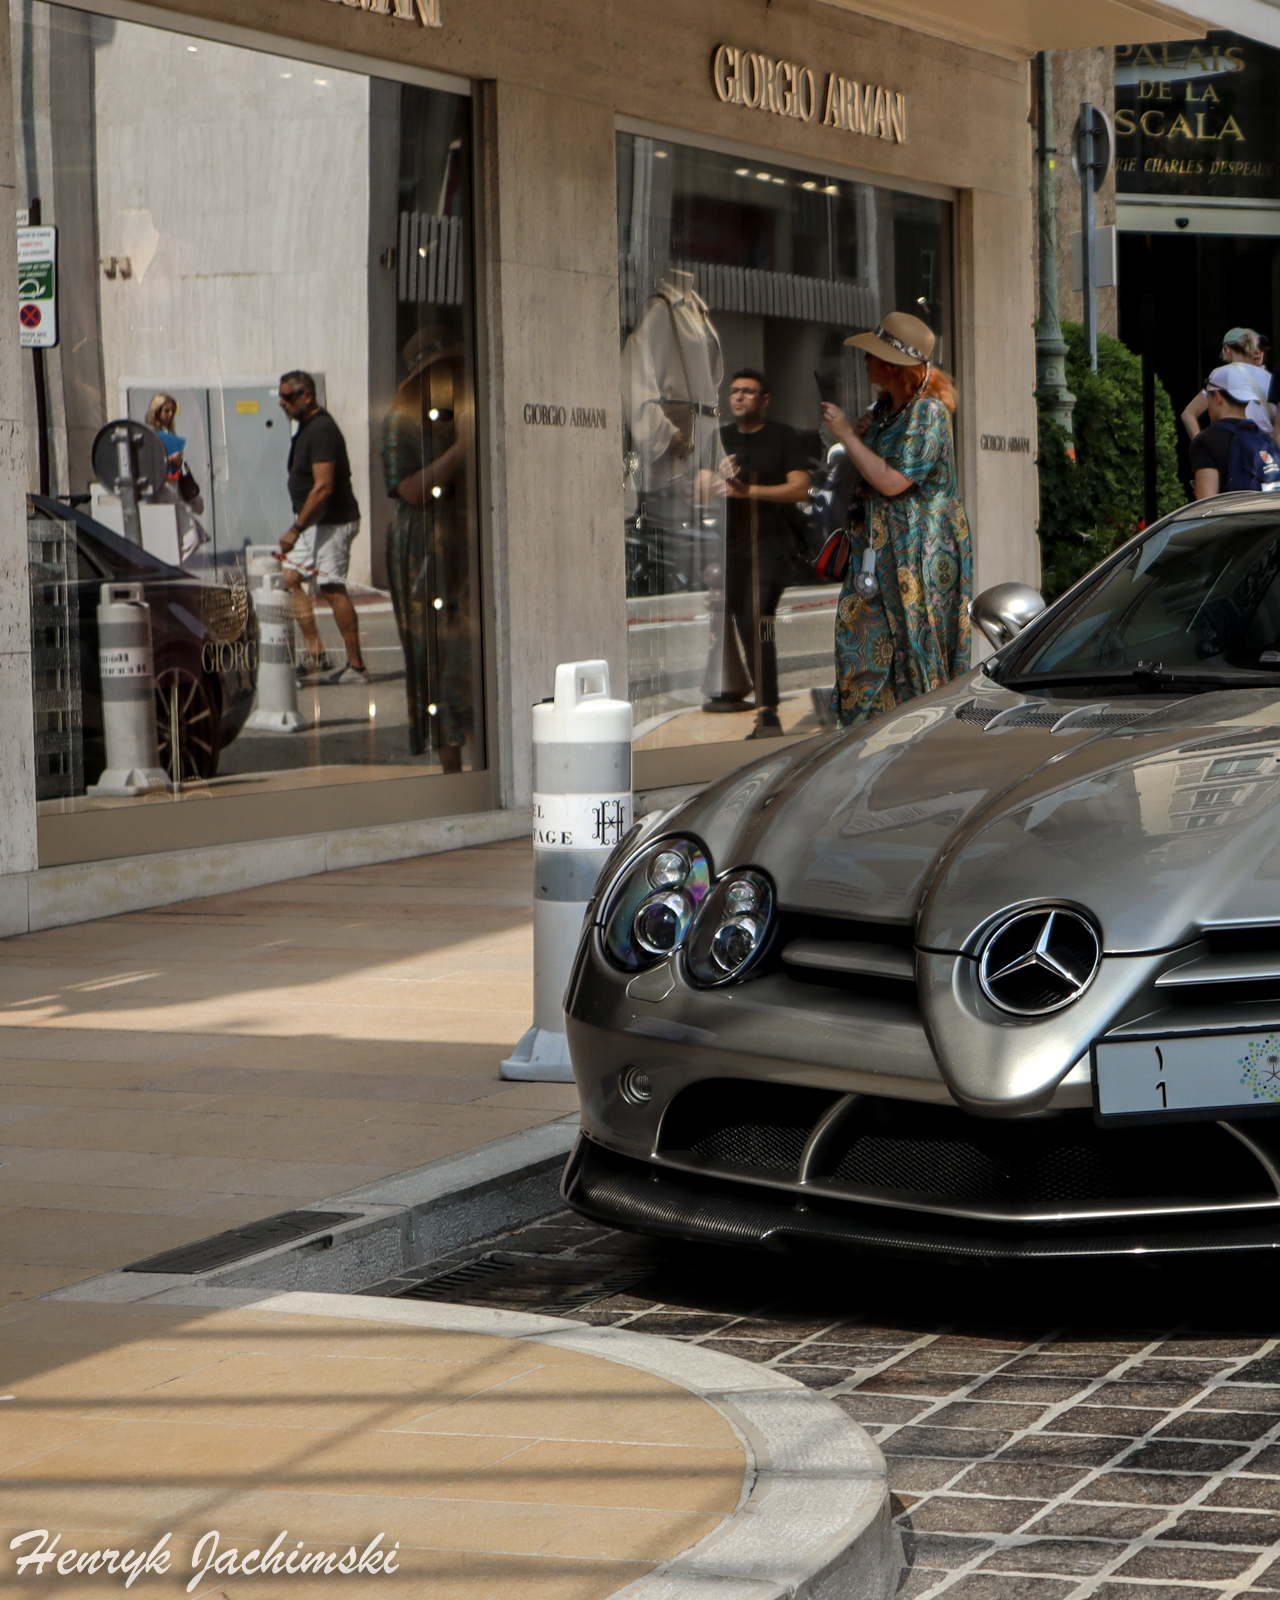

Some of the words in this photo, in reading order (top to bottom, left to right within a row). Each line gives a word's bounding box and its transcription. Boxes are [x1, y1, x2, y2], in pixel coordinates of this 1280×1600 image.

[1114, 42, 1246, 72] PALAIS
[714, 44, 817, 122] GIORGIO
[822, 71, 907, 144] ARMANI
[1137, 79, 1172, 100] DE
[1184, 81, 1221, 103] LA
[1115, 108, 1246, 141] SCALA
[1144, 158, 1203, 174] CHARLES
[523, 403, 567, 427] GIORGIO
[569, 406, 607, 429] ARMANI
[1155, 1080, 1167, 1108] 1
